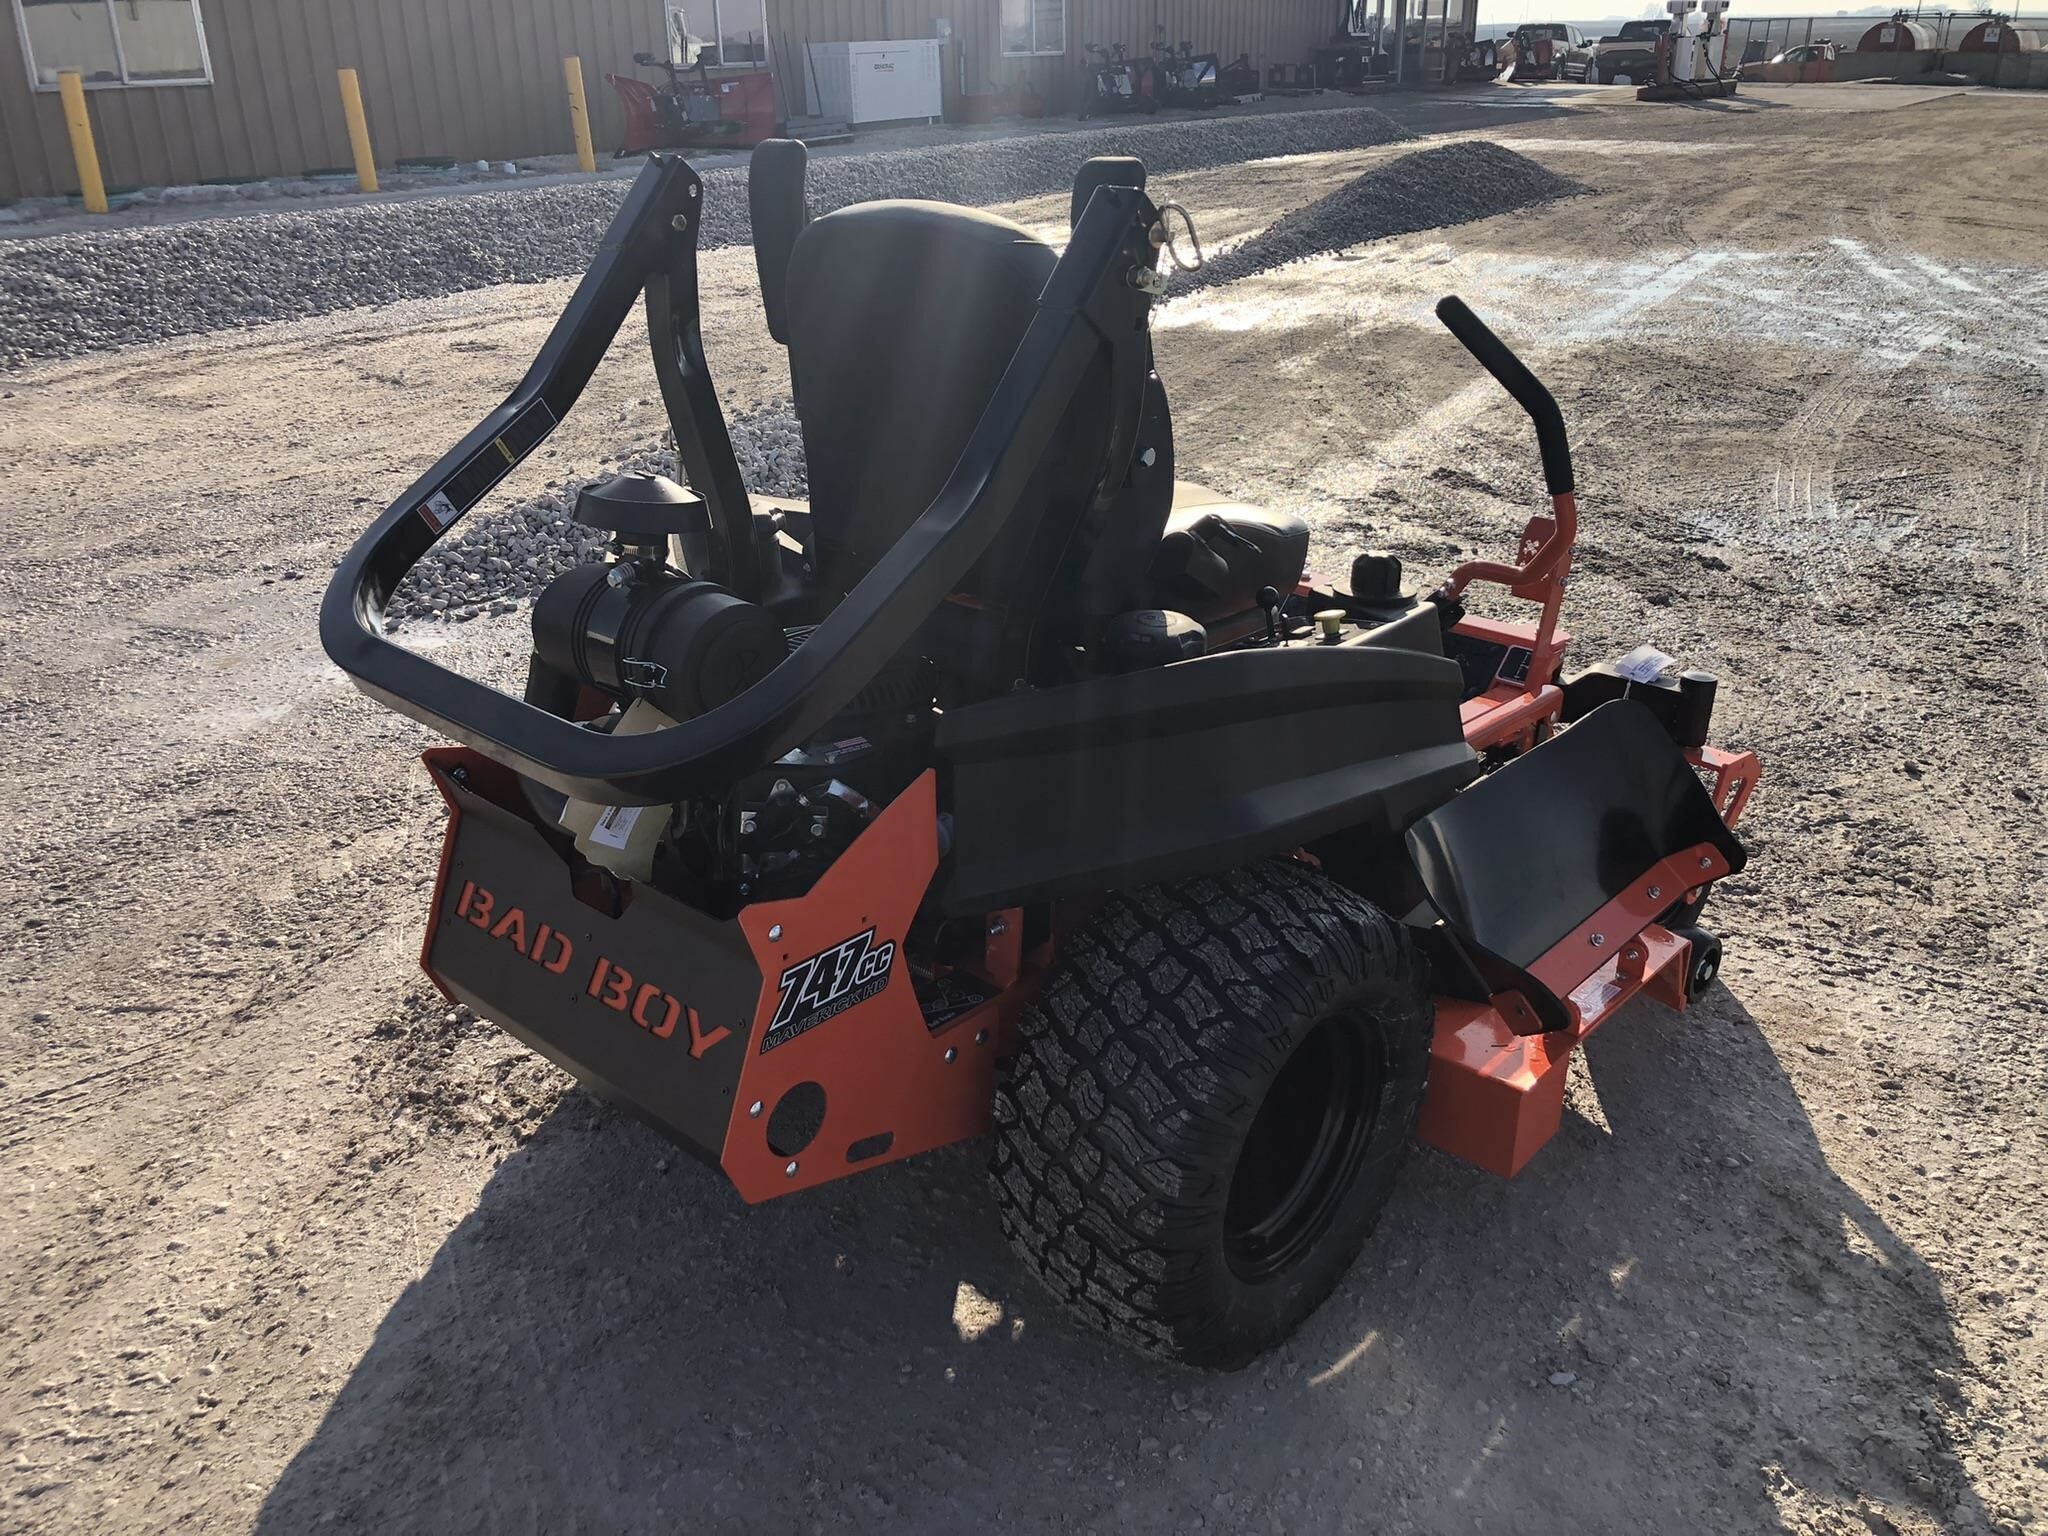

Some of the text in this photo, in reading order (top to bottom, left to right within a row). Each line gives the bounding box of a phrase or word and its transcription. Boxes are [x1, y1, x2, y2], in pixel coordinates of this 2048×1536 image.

[456, 880, 733, 1060] BAD BOY
[761, 976, 888, 1053] MAVERICK HD
